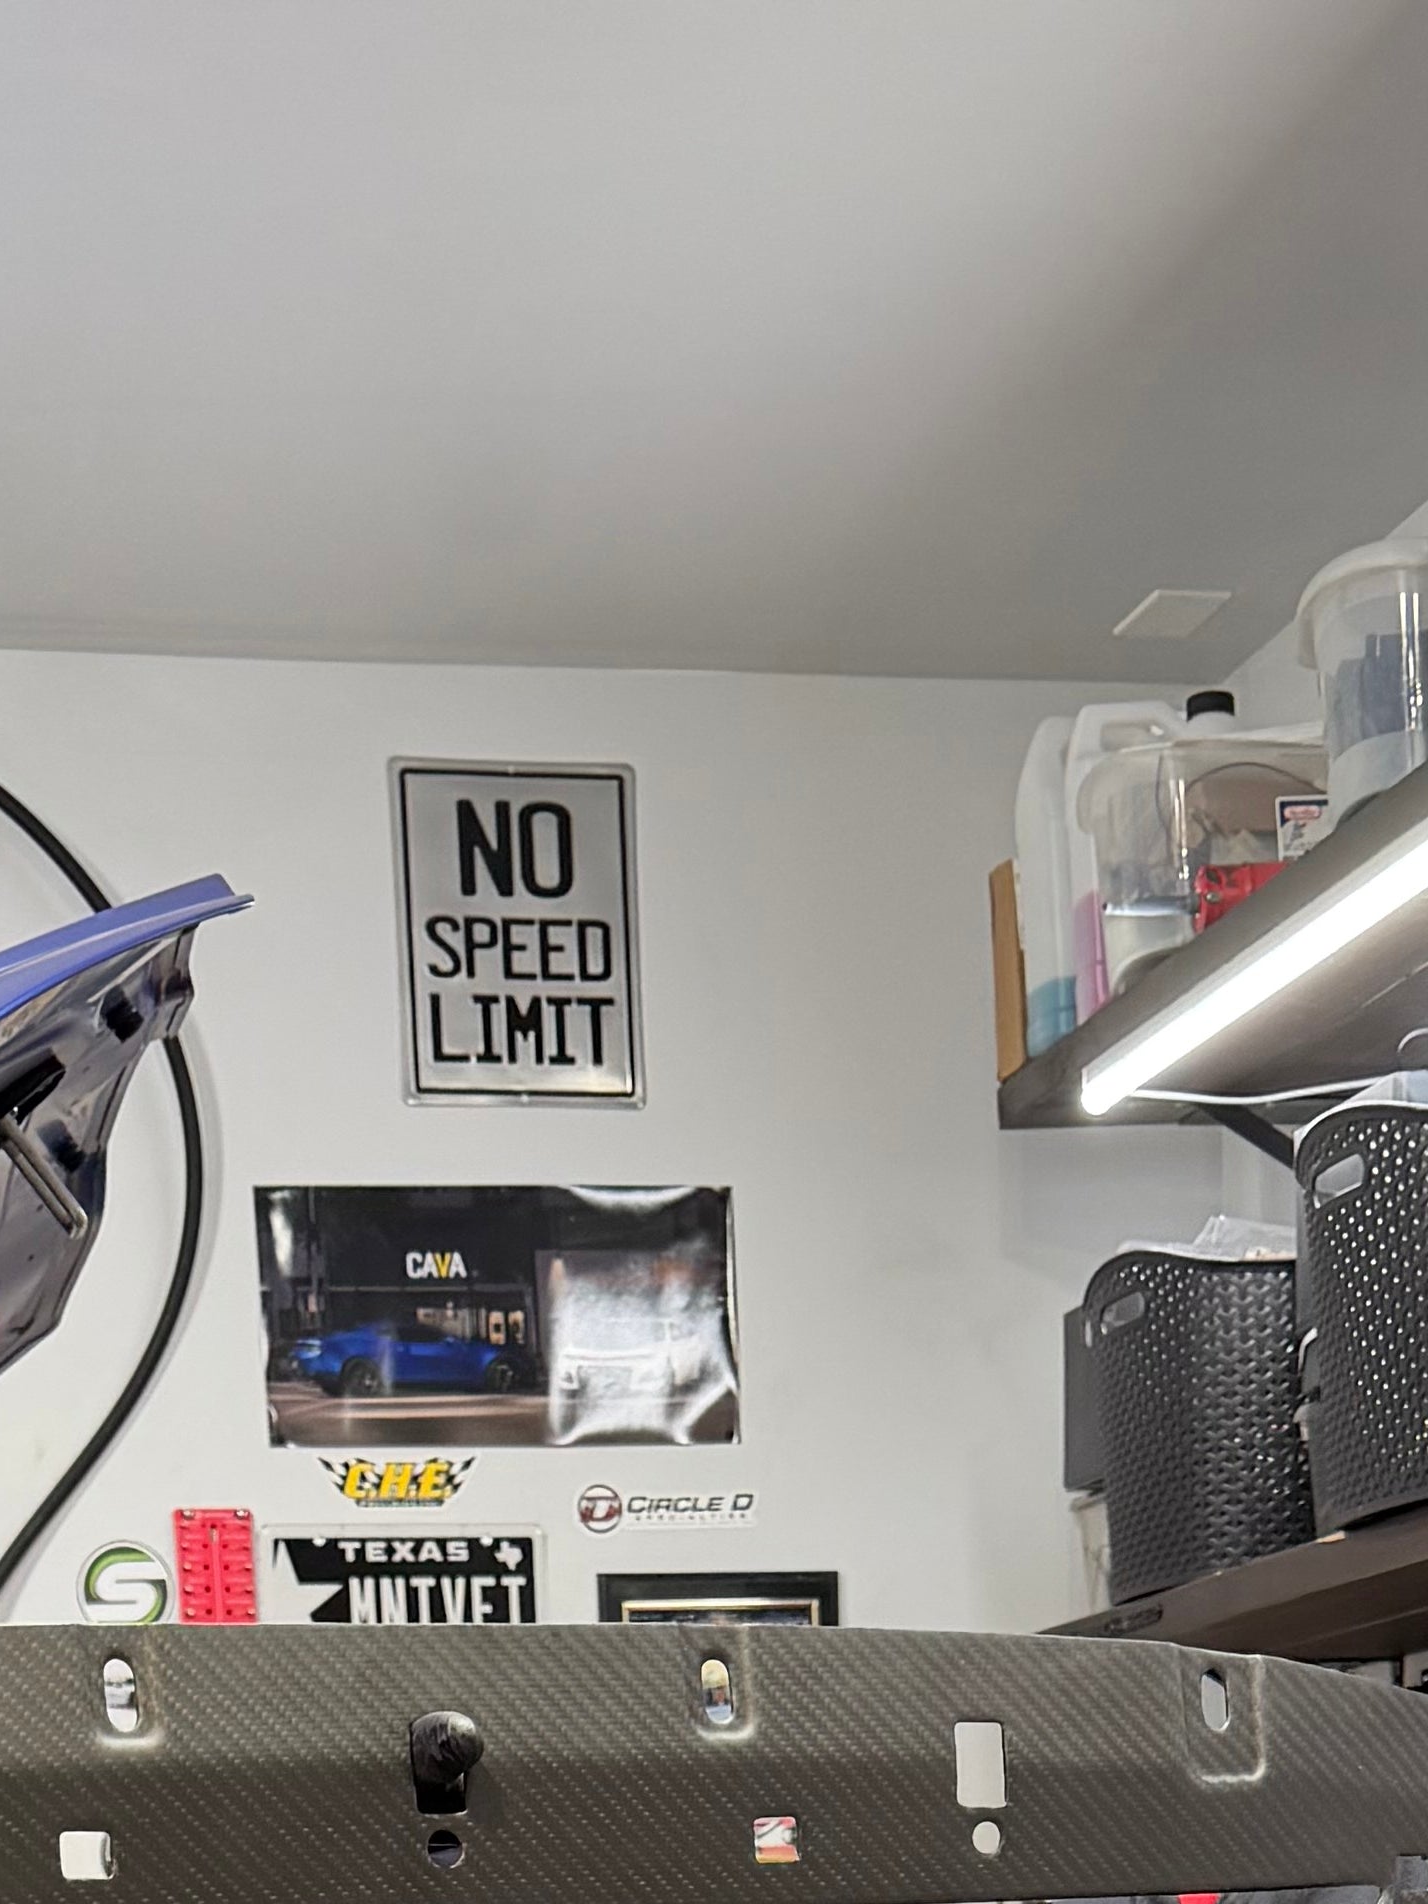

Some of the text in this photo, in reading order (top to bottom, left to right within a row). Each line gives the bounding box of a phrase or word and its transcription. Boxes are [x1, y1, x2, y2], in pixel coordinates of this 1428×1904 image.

[456, 799, 574, 899] NO
[425, 914, 613, 982] SPEED
[429, 993, 615, 1066] LIMIT
[405, 1251, 468, 1279] CAVA
[627, 1493, 754, 1513] CIRCLE D
[337, 1541, 470, 1563] TEXAS
